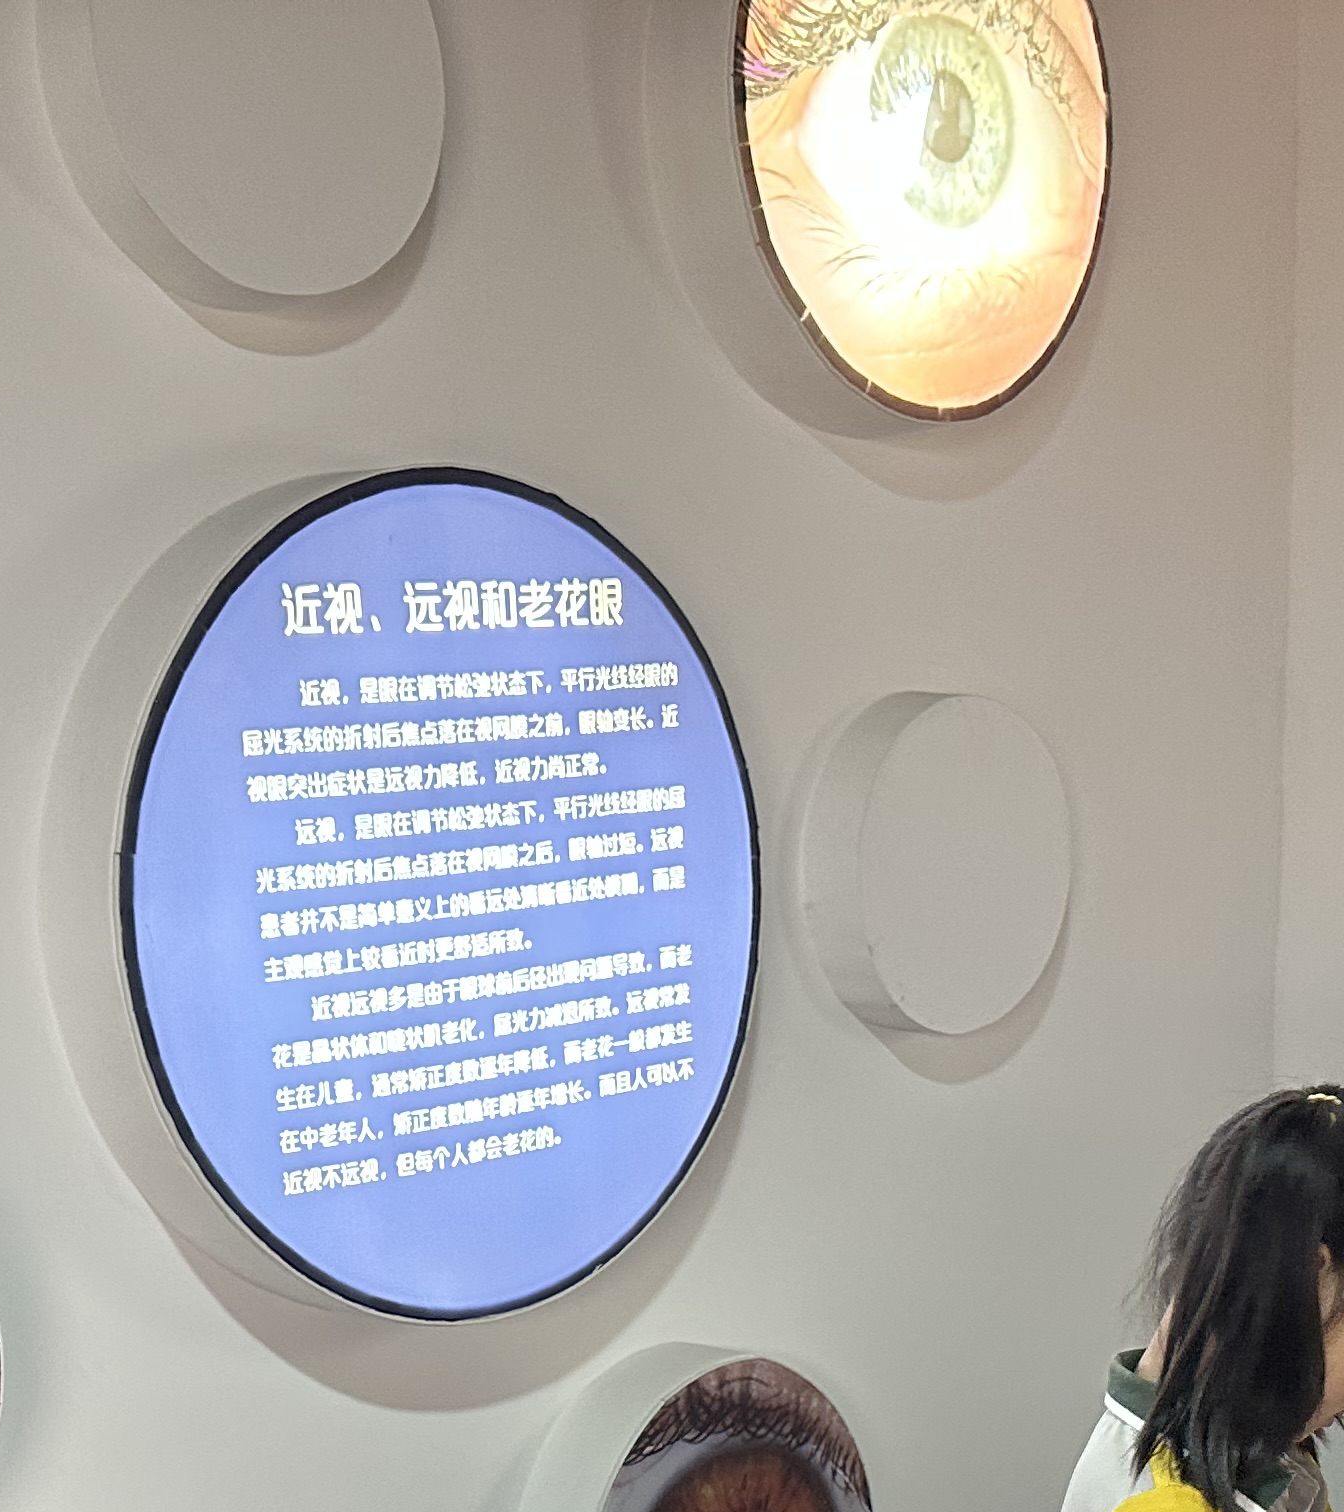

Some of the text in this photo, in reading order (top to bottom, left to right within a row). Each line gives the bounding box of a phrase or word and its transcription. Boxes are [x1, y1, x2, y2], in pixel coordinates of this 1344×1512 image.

[281, 578, 624, 636] 近视、远视和老花眼
